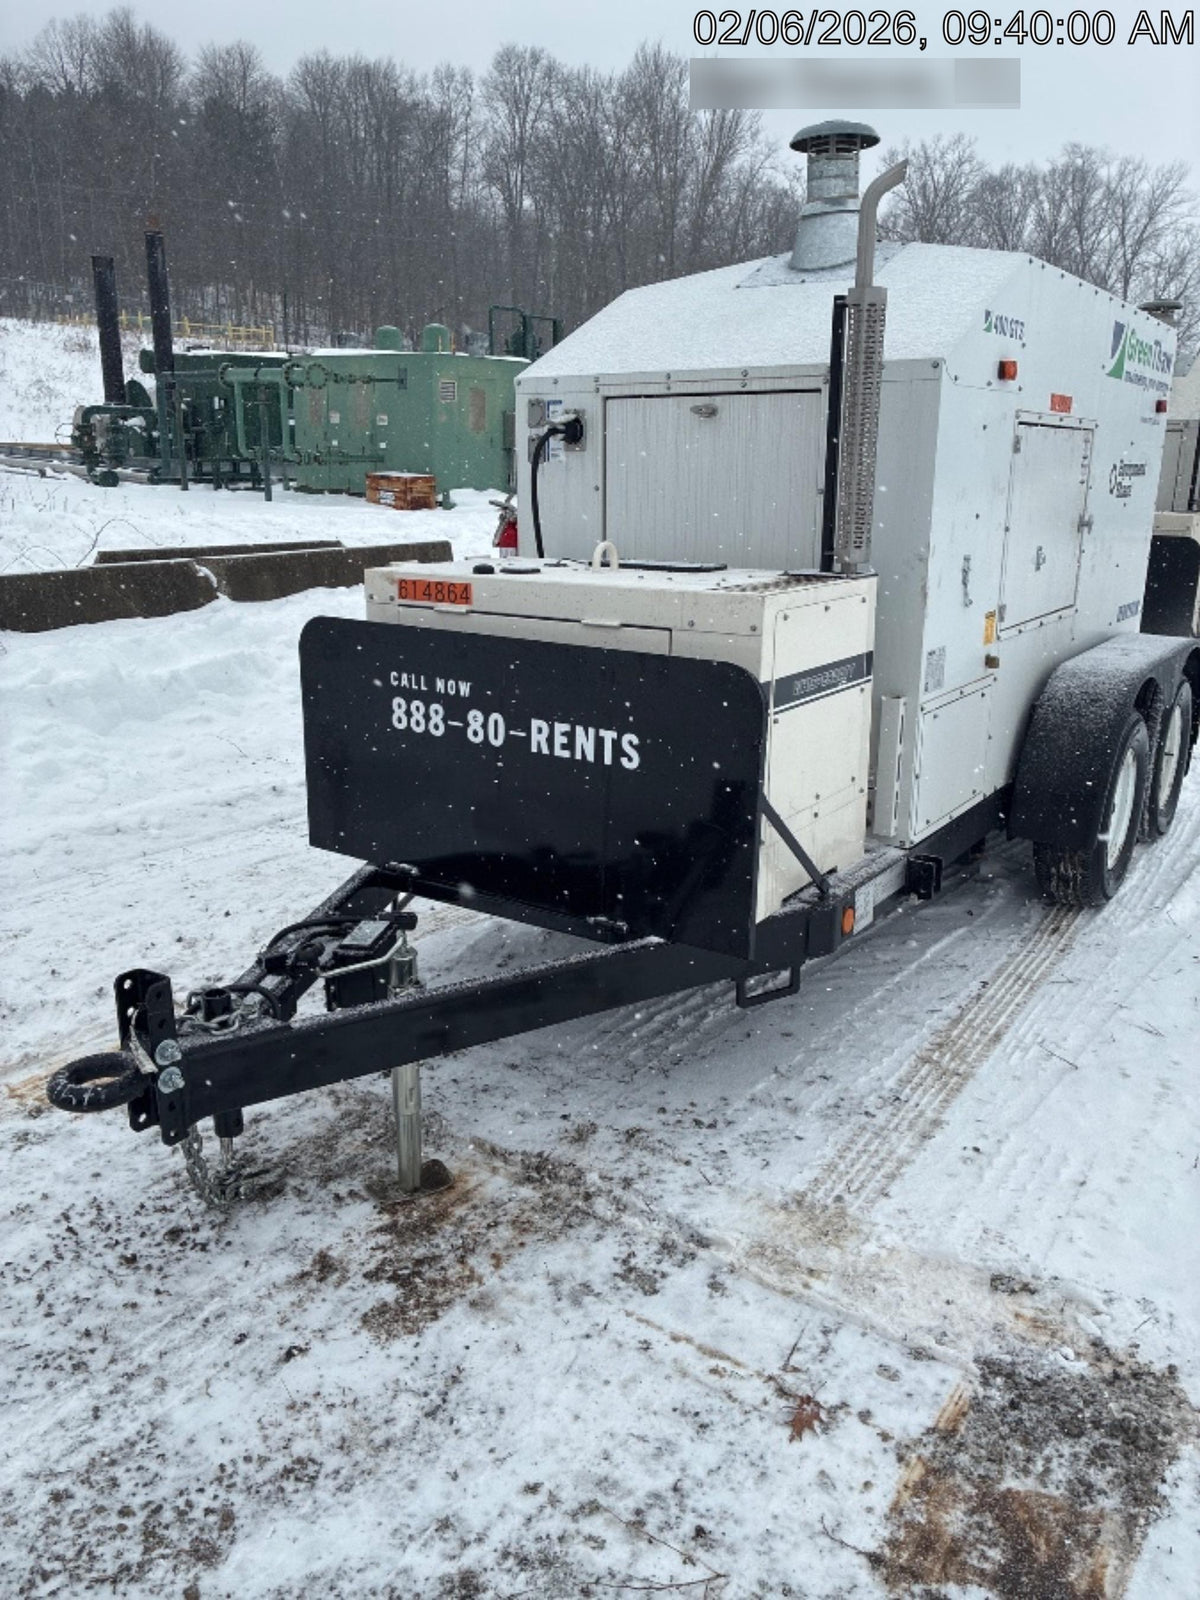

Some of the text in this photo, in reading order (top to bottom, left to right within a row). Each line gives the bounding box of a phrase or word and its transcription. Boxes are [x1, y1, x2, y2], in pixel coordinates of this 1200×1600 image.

[398, 579, 470, 604] 614864
[390, 671, 472, 698] CALL NOW
[391, 696, 641, 771] 888-80-RENTS
